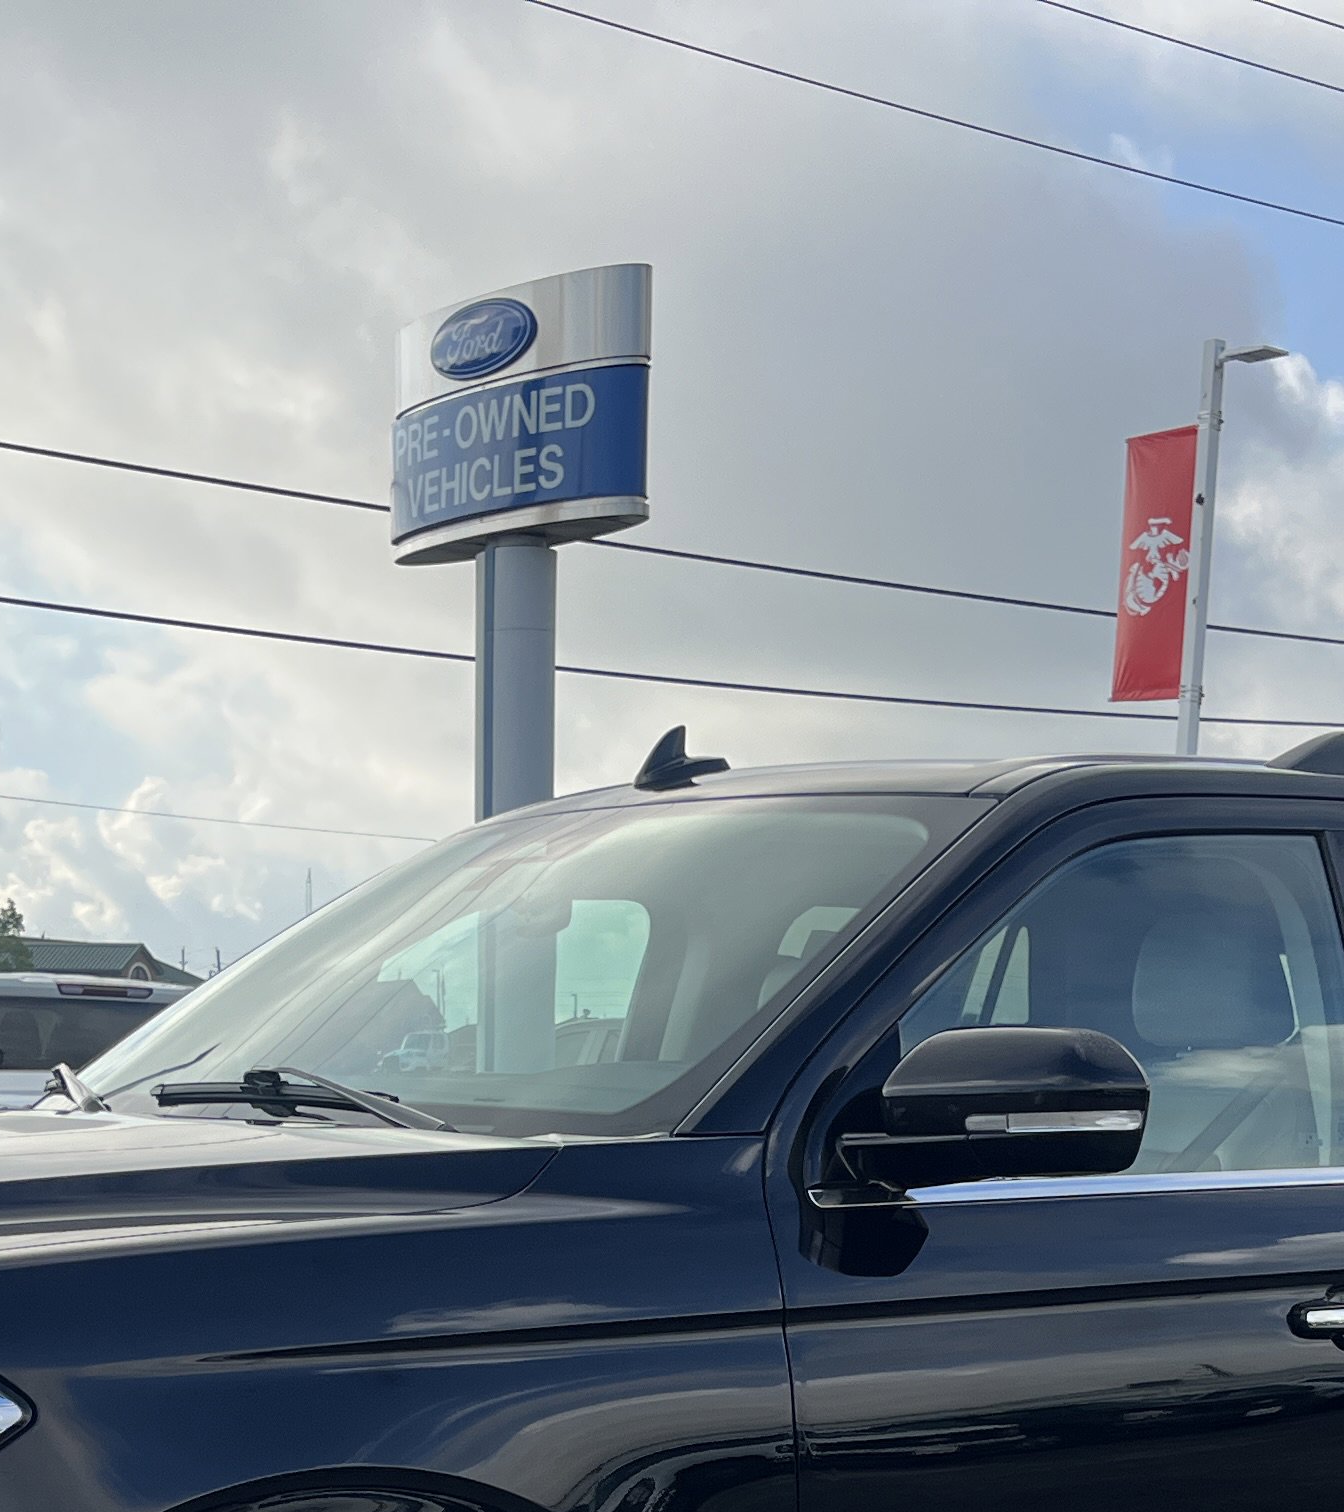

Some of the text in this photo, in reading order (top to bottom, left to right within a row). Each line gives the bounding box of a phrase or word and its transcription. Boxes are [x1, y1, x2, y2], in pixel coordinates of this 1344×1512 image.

[446, 314, 505, 364] Ford
[395, 383, 596, 472] PRE-OWNED
[407, 444, 565, 518] VEHICLES
